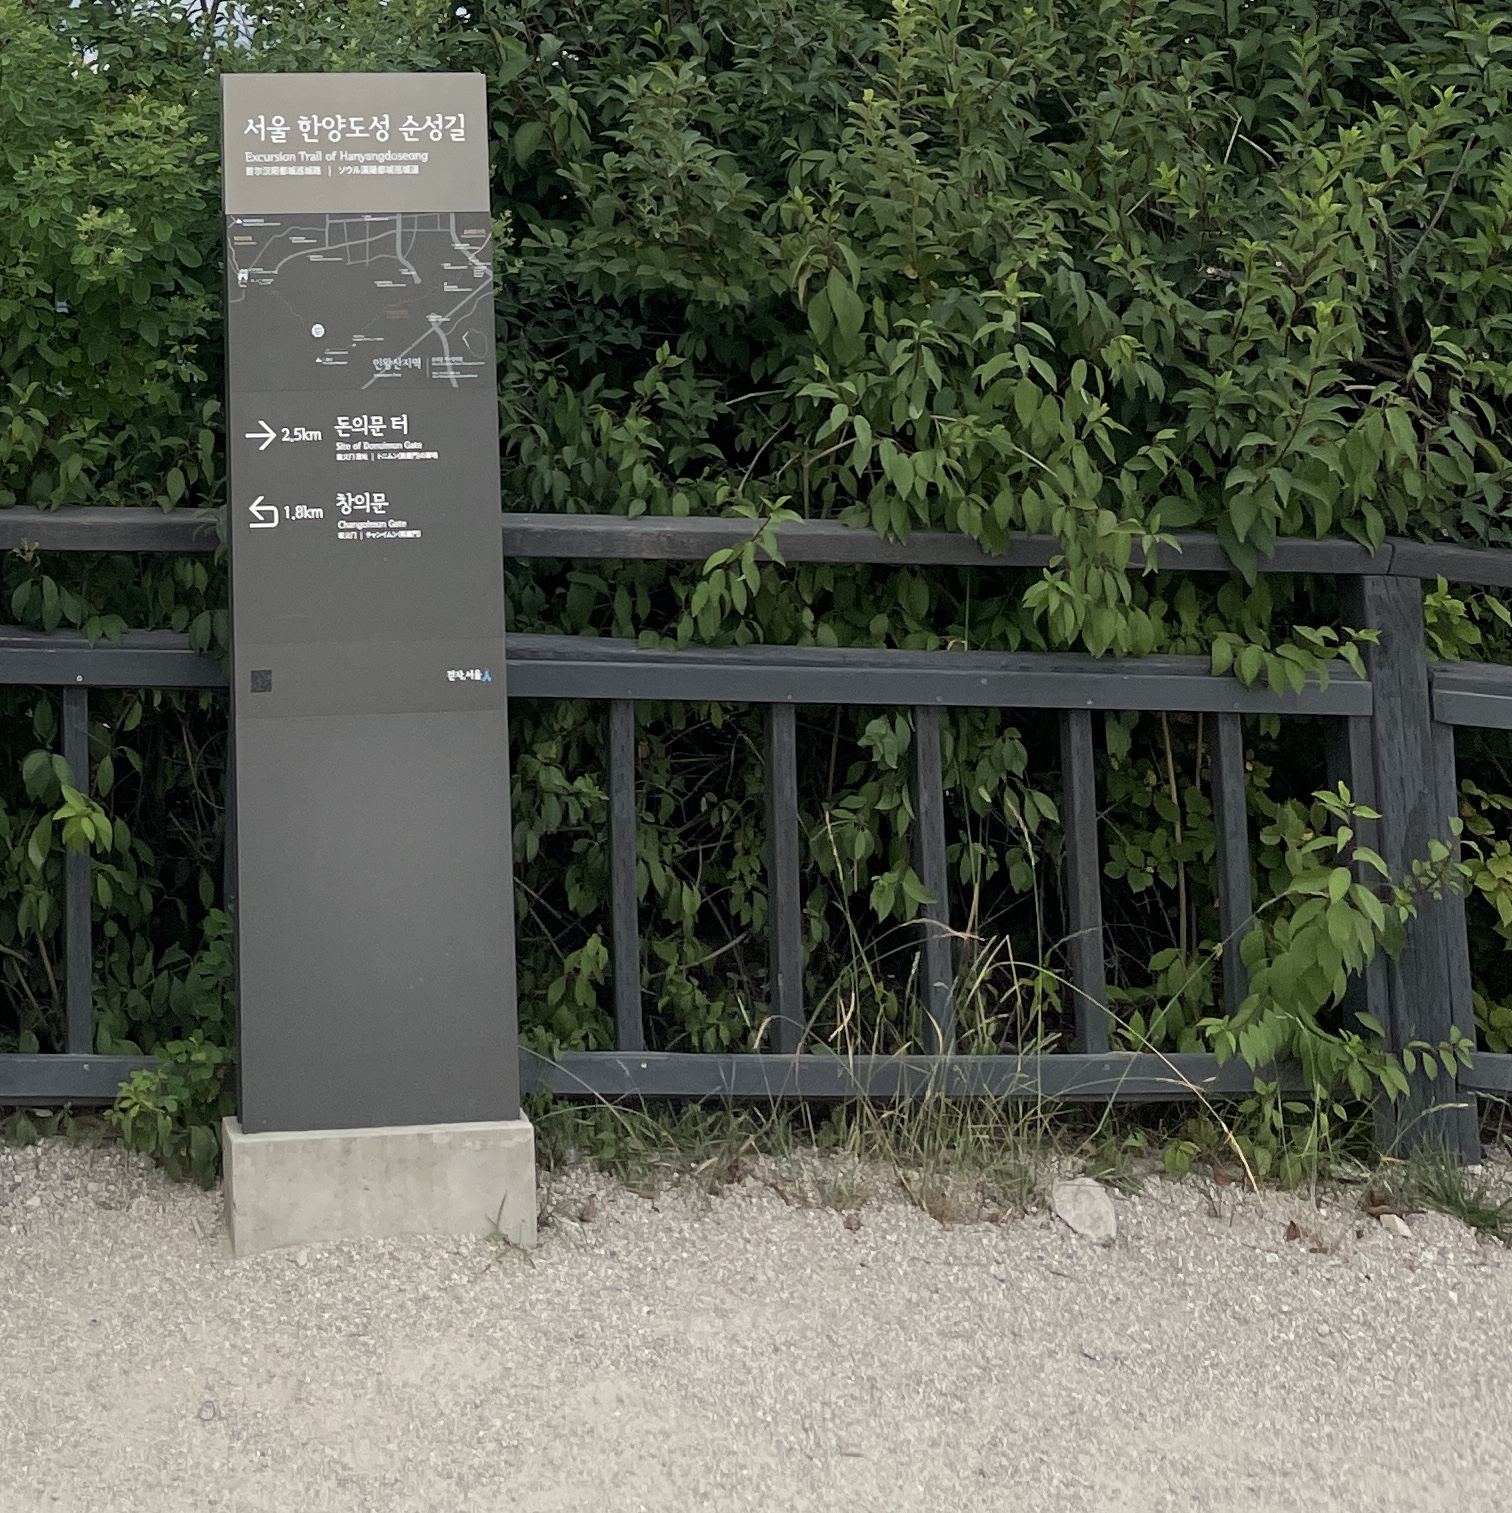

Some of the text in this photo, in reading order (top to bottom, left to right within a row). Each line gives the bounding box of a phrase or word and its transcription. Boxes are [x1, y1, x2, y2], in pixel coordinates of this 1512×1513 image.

[243, 113, 466, 143] 서울 한양도성 순성길
[245, 150, 429, 163] Excursion Trail of Hanyangdoseong
[281, 427, 322, 443] 2.5km
[334, 414, 408, 437] 돈의문 터
[284, 505, 324, 521] 1.8km
[336, 492, 389, 515] 창의문
